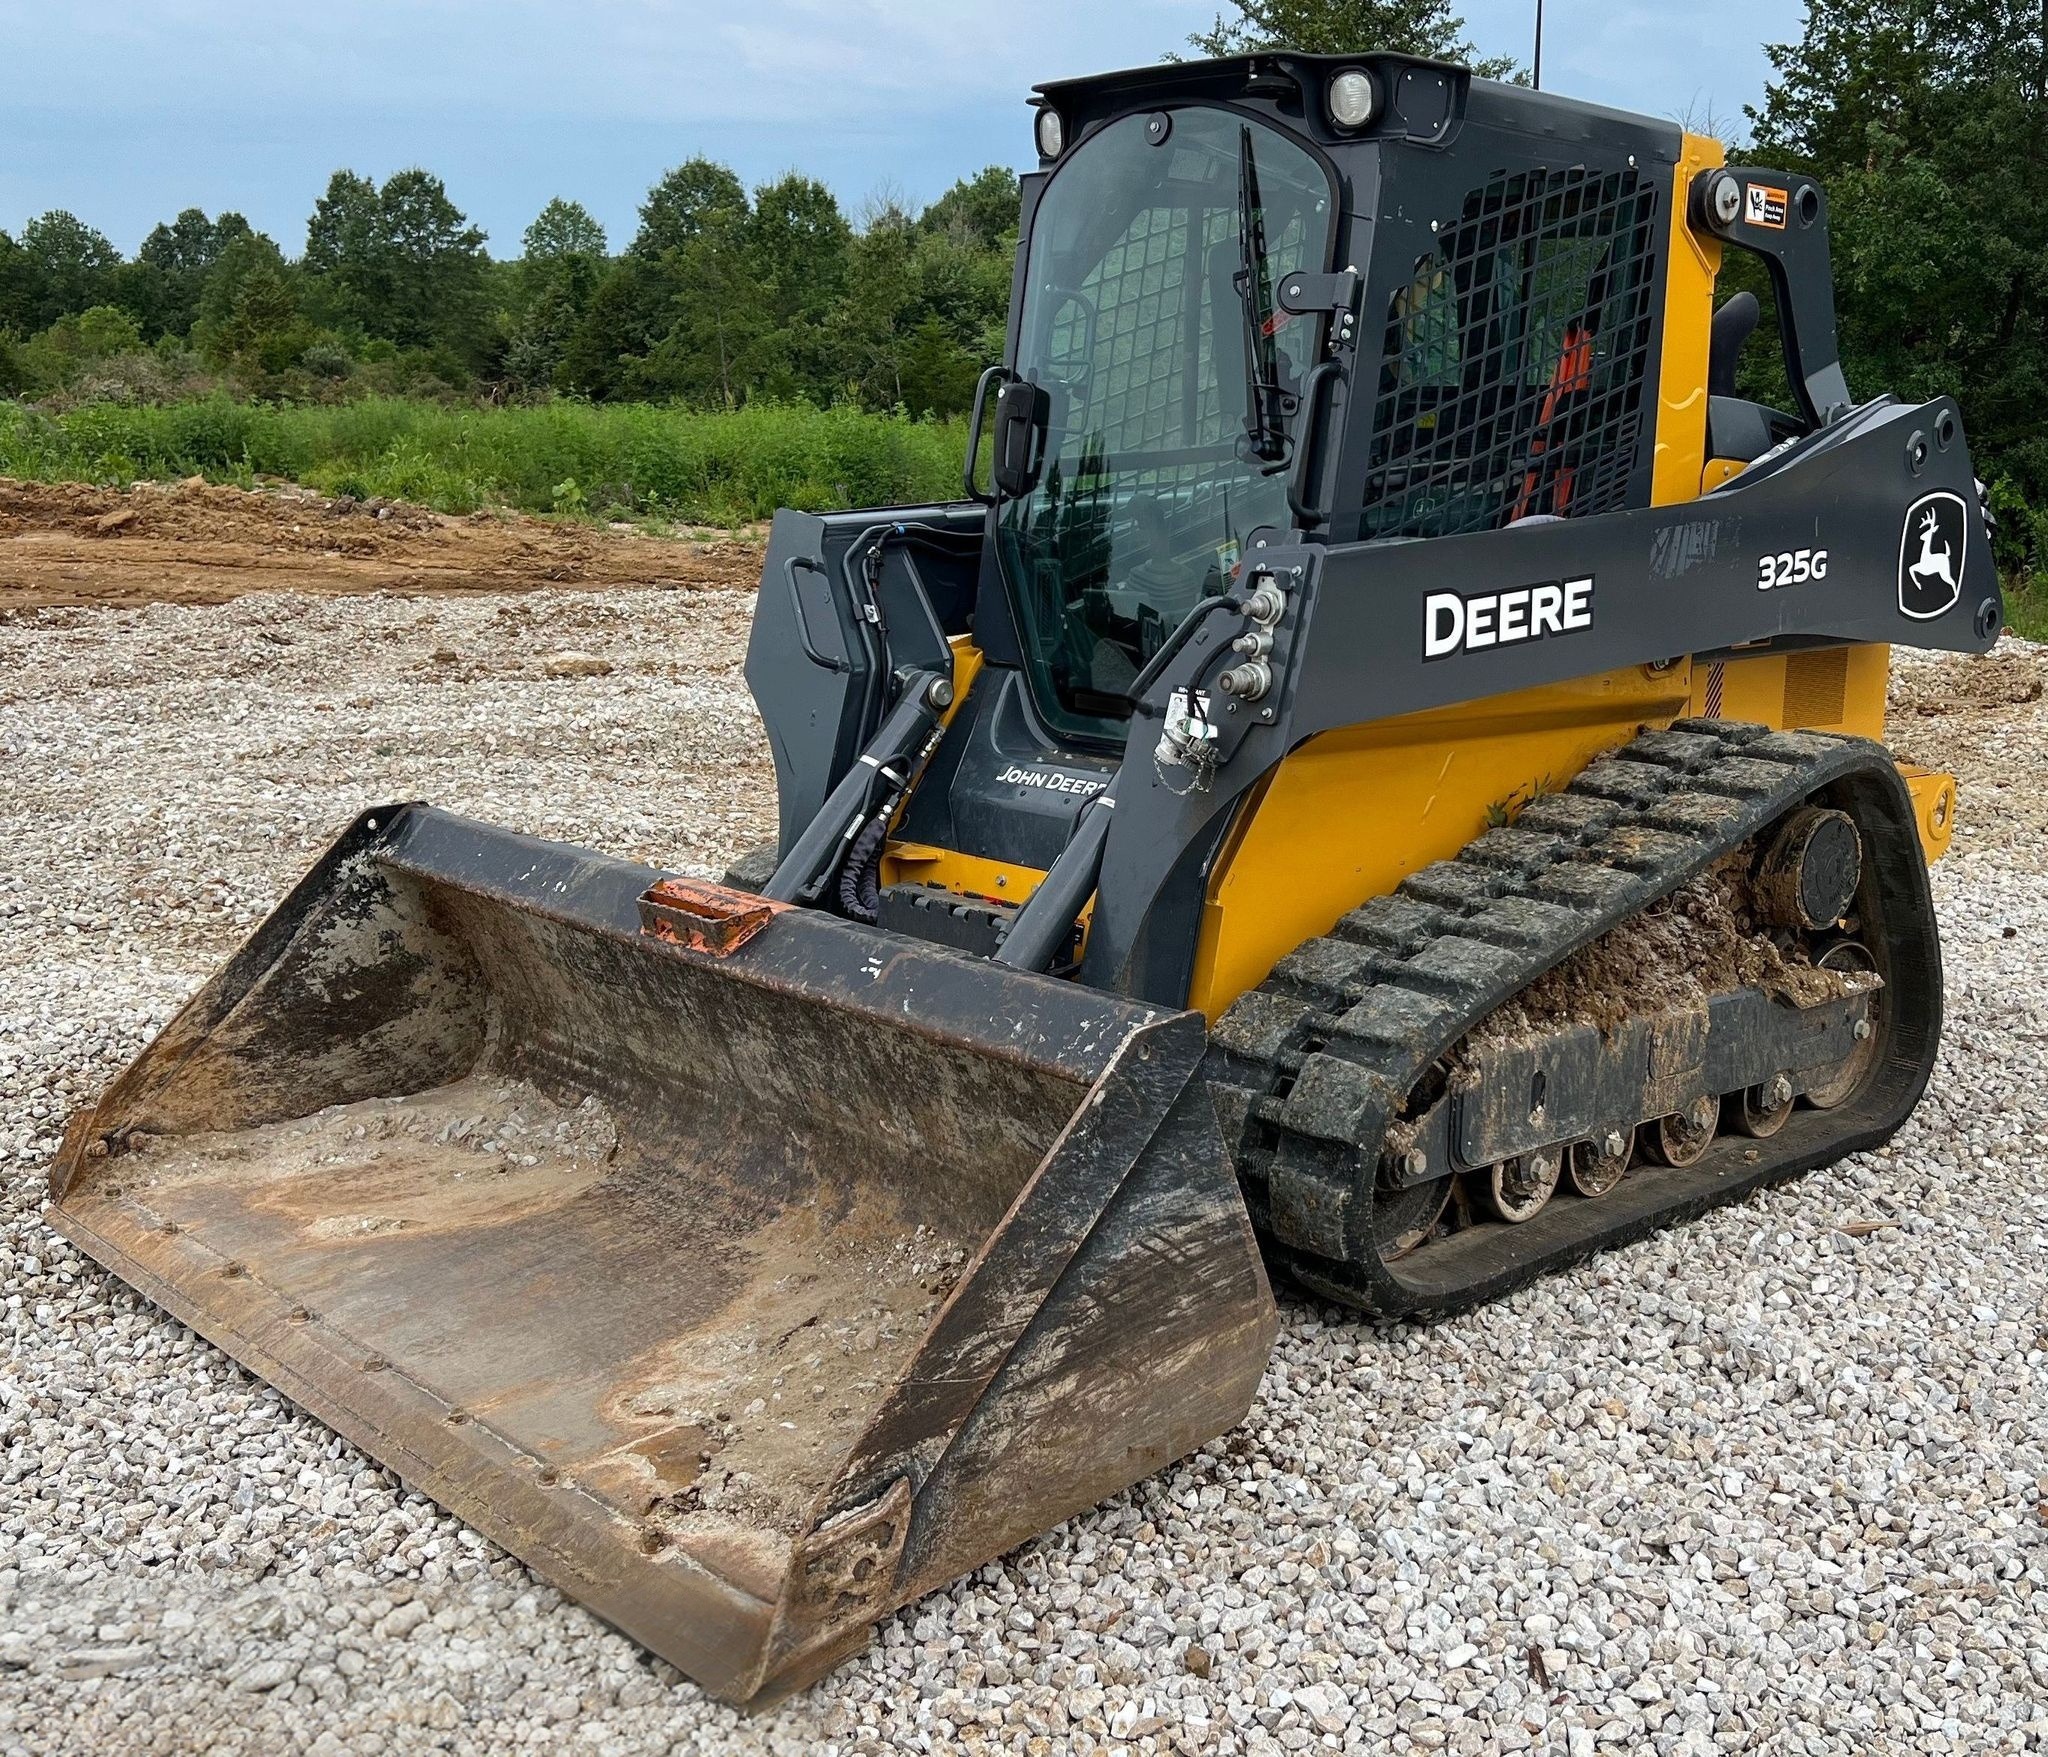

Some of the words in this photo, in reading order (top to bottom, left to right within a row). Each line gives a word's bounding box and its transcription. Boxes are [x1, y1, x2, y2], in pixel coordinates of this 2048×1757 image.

[1757, 548, 1828, 589] 325G
[1425, 578, 1593, 657] DEERE
[1177, 686, 1206, 696] IMPANT
[995, 765, 1048, 788] JOHN
